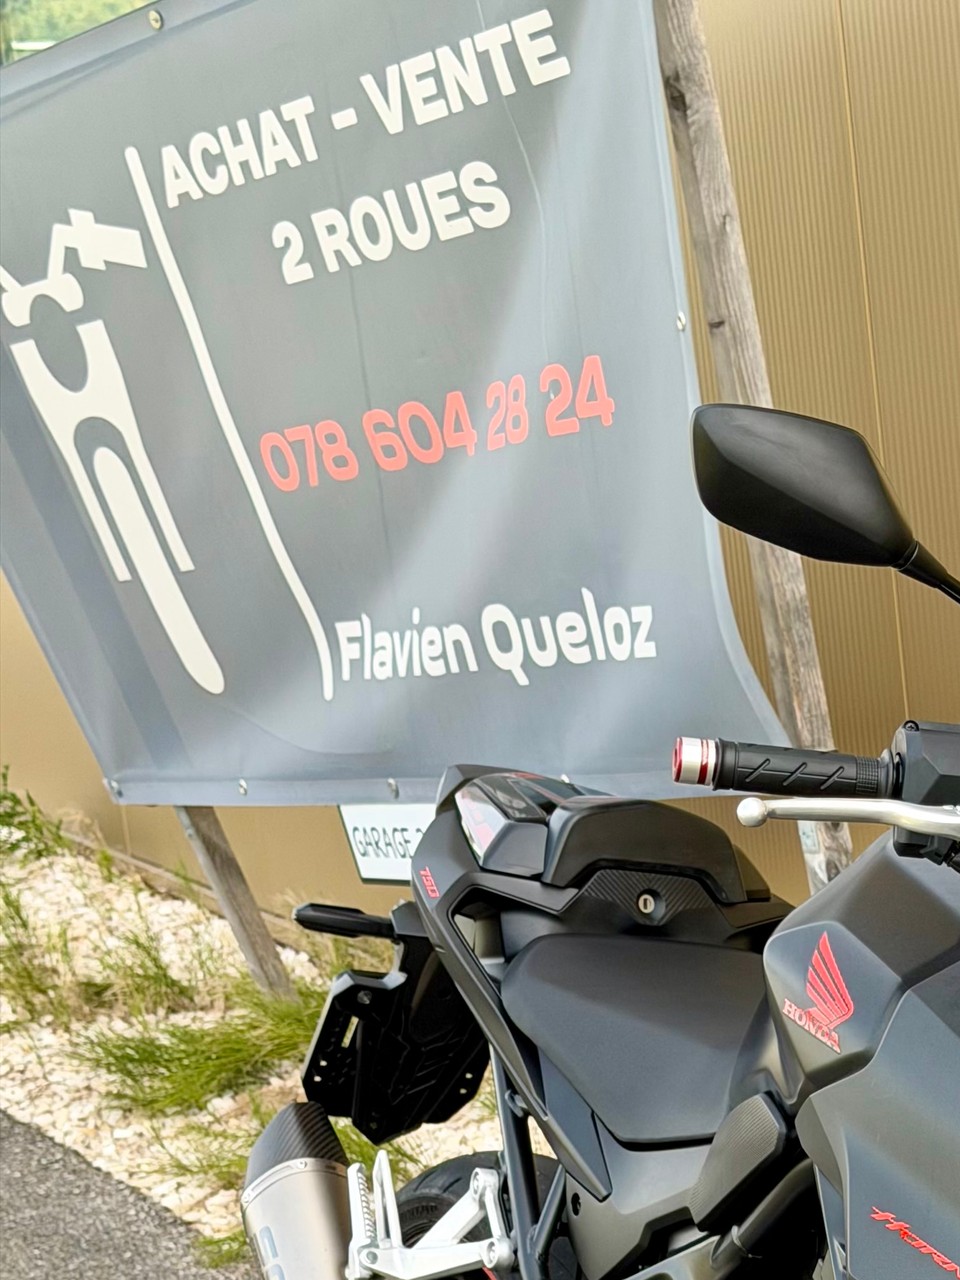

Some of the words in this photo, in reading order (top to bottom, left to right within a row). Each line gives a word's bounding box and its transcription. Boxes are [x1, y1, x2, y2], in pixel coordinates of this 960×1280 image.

[161, 95, 319, 209] ACHAT
[360, 8, 571, 135] VENTE
[271, 220, 314, 285] 2
[310, 160, 511, 273] ROUES
[259, 420, 359, 492] 078
[362, 390, 477, 471] 604
[486, 374, 529, 450] 28
[538, 355, 615, 436] 24
[334, 606, 479, 682] Flavien
[481, 586, 657, 686] Queloz
[353, 826, 412, 859] GARAGE
[782, 997, 842, 1055] HONDA
